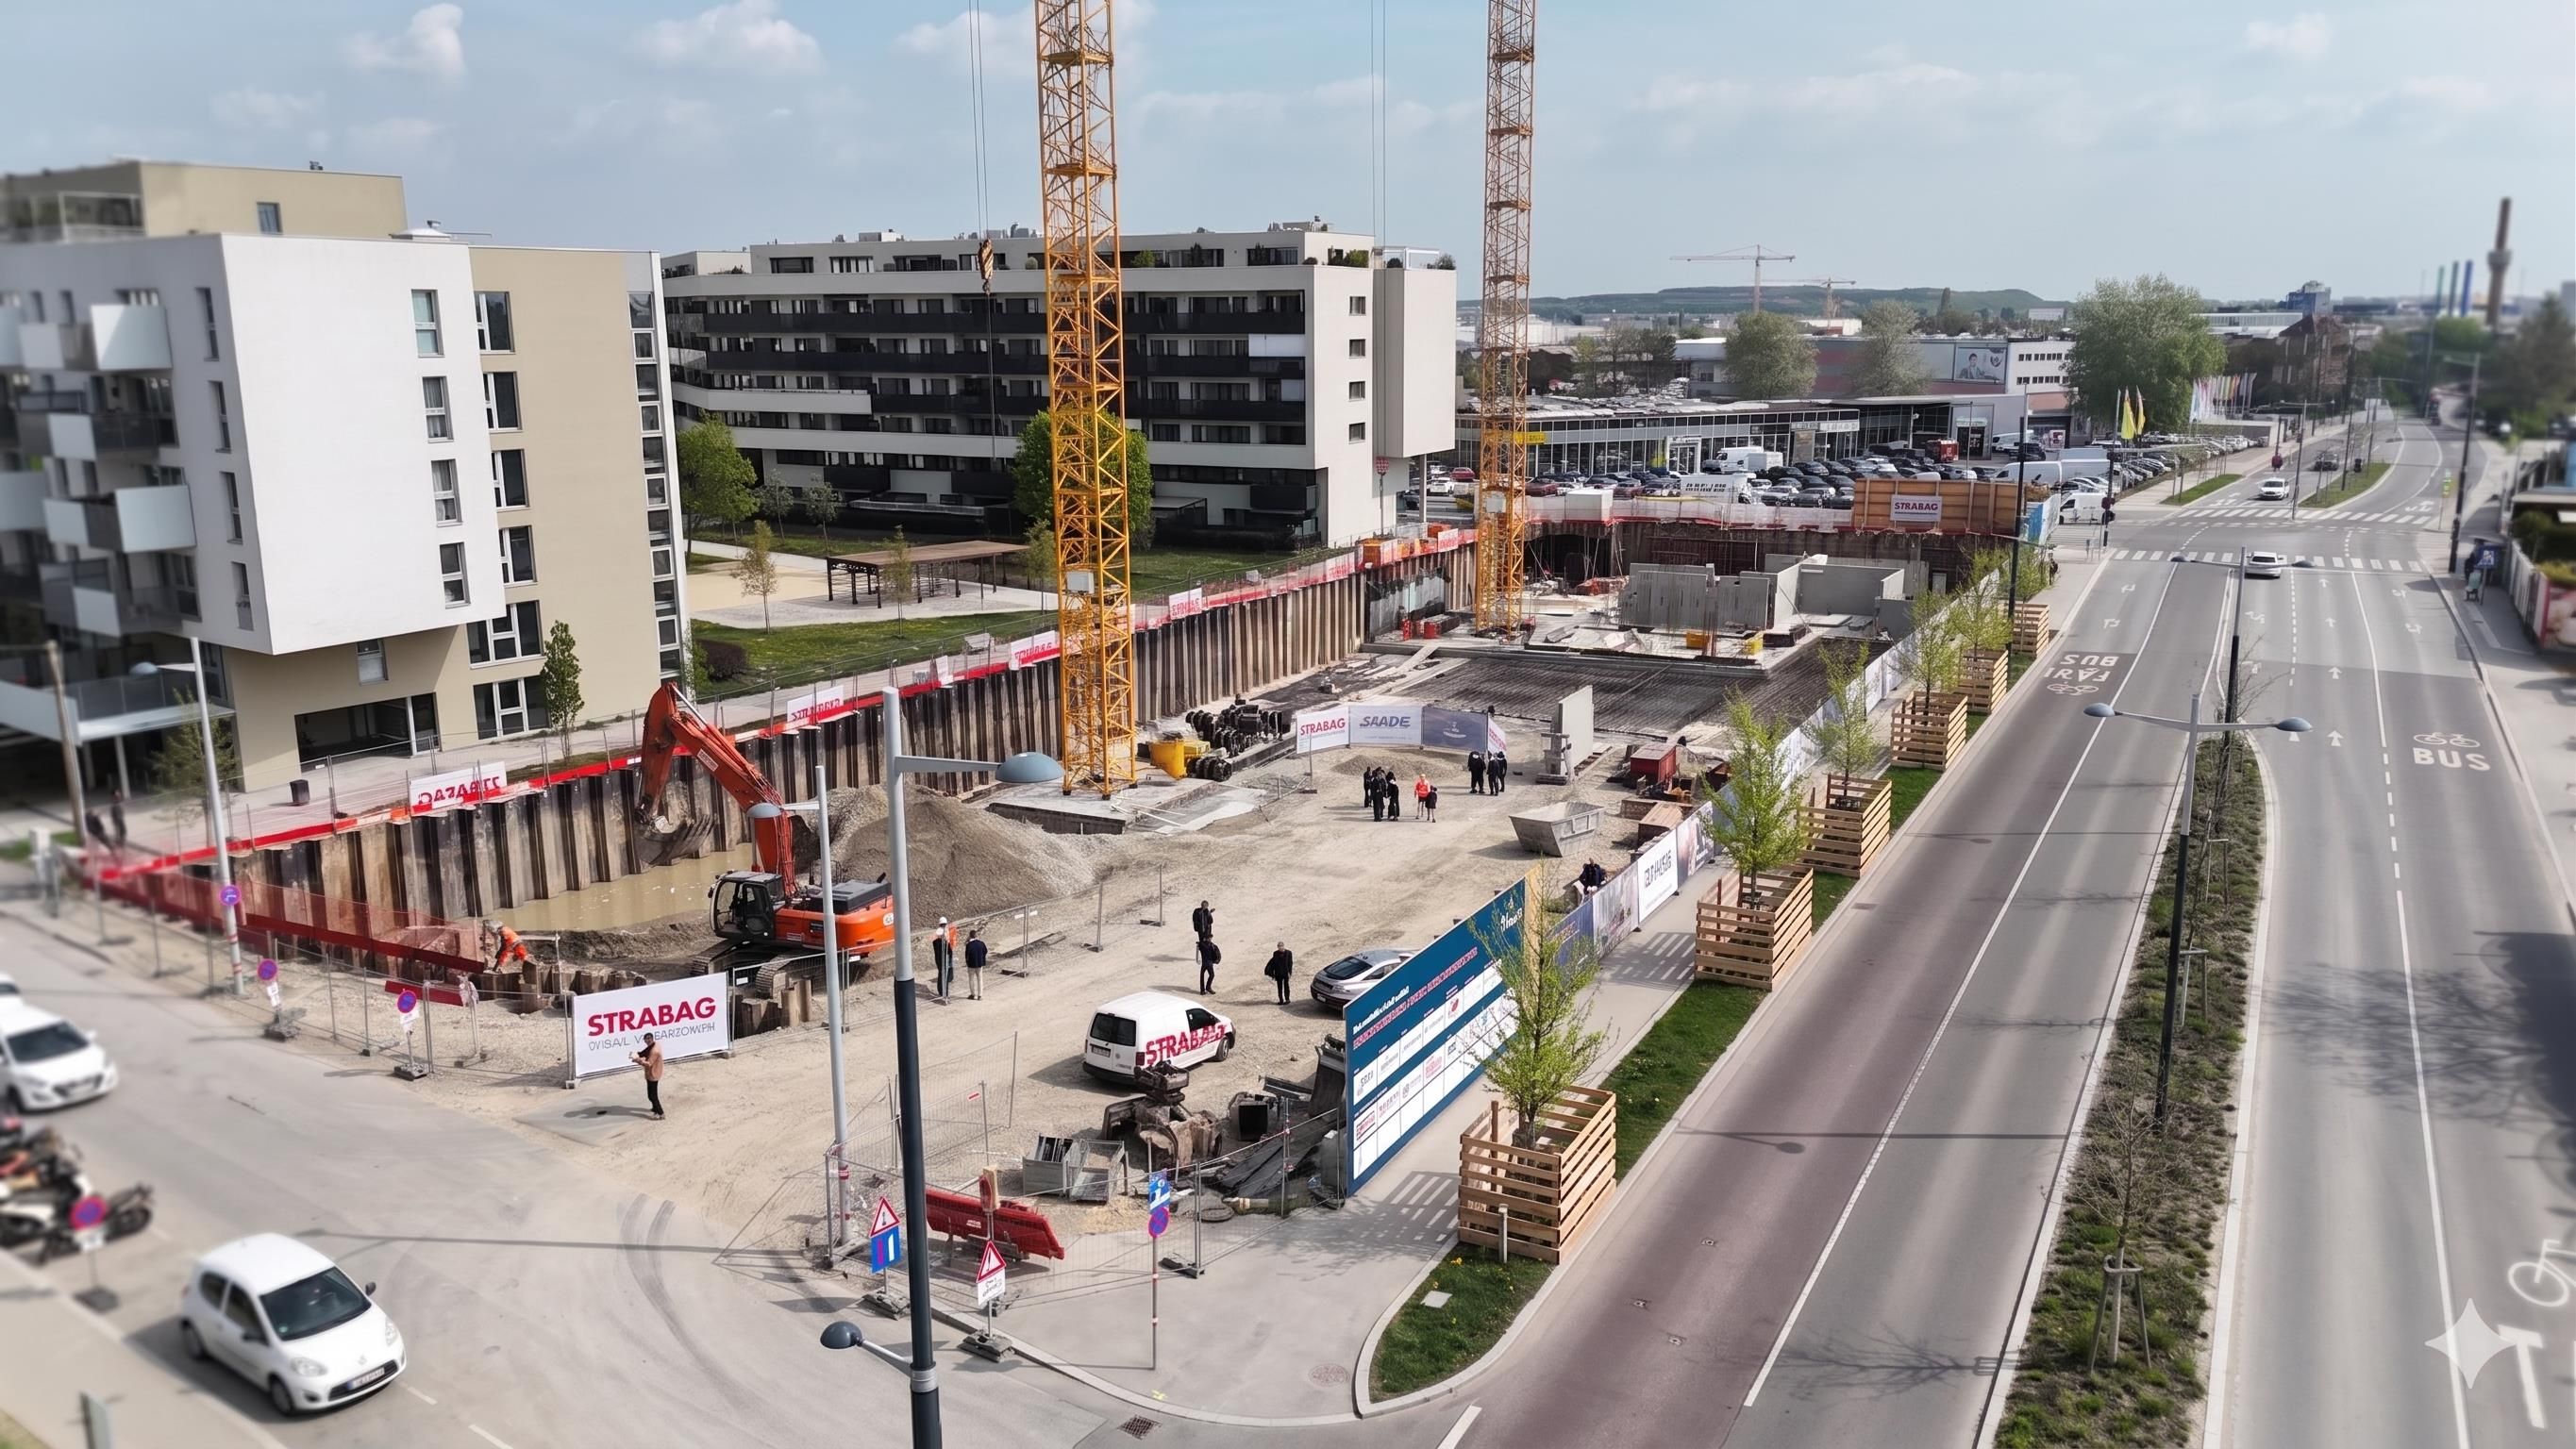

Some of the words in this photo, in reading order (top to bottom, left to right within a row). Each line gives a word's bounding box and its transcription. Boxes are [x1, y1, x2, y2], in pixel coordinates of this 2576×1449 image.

[1894, 502, 1939, 511] STRABAG
[2060, 654, 2119, 666] BUS
[1300, 718, 1346, 736] STRABAG
[2413, 747, 2491, 771] BUS
[588, 997, 716, 1037] STRABAG
